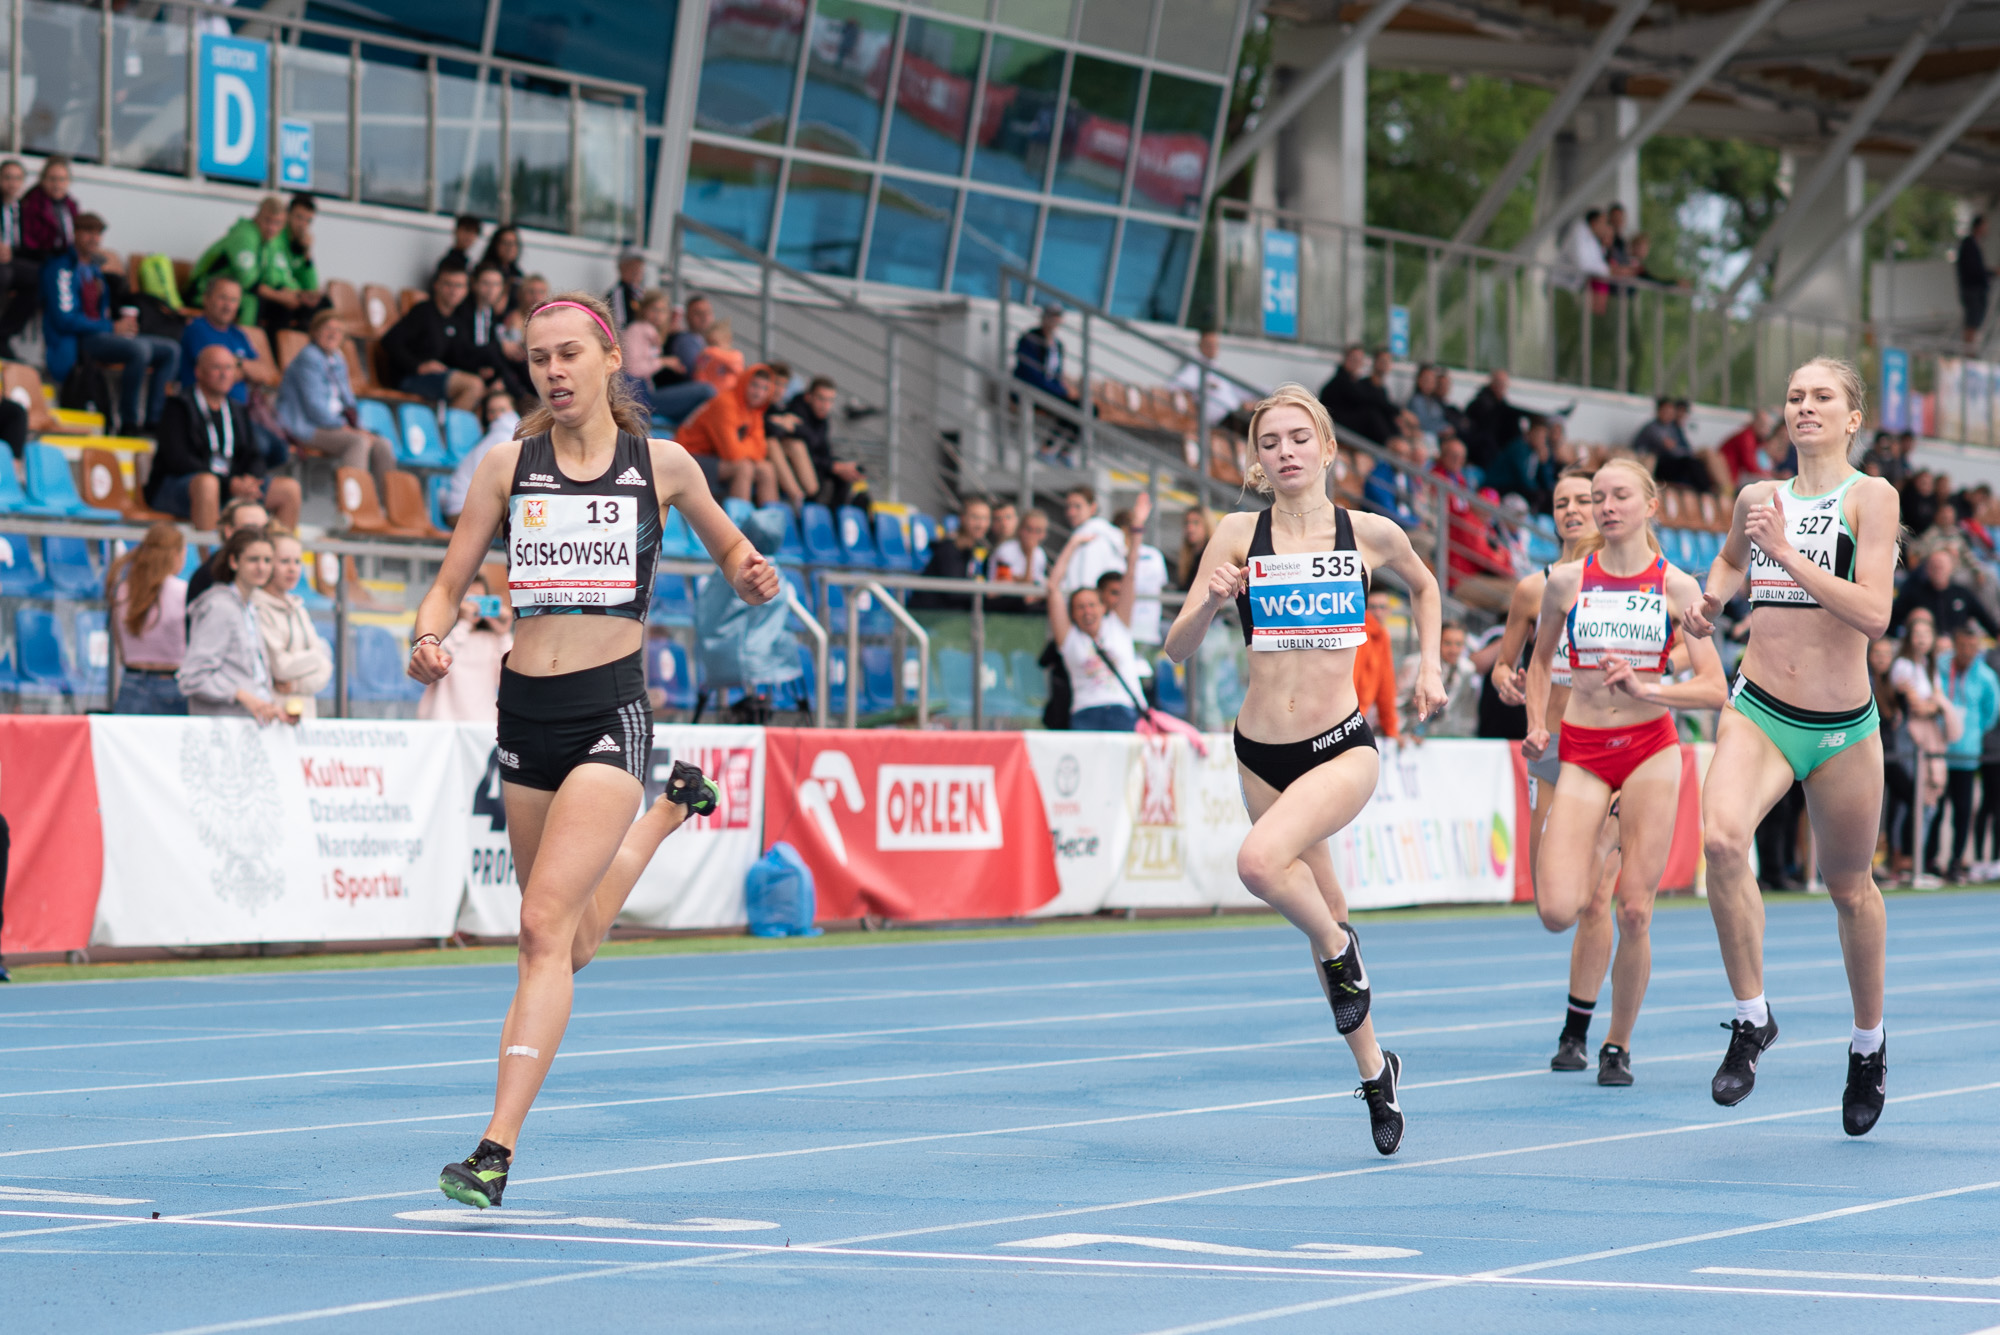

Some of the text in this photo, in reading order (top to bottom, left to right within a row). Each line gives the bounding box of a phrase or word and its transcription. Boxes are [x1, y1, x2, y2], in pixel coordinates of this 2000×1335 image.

[214, 72, 256, 166] D
[529, 473, 554, 482] SMS
[615, 478, 647, 486] adidas
[586, 501, 619, 524] 13
[1796, 515, 1833, 535] 527
[516, 538, 630, 566] ŚCISŁOWSKA
[1264, 562, 1301, 572] lubelskie
[1312, 556, 1355, 578] 535
[534, 592, 606, 603] LUBLIN 2021
[1259, 590, 1357, 617] WÓJCIK
[1626, 595, 1662, 614] 574
[1757, 590, 1809, 601] LUBLIN 2021
[1578, 621, 1662, 642] WOJTKOWIAK
[1277, 638, 1342, 648] LUBLIN 2021
[1312, 711, 1364, 752] NIKE PRO
[589, 745, 620, 755] adidas
[301, 757, 384, 796] Kultury
[309, 797, 413, 823] Dziedzictwa
[887, 780, 990, 836] ORLEN
[316, 833, 424, 864] Narodowego
[993, 1233, 1424, 1260] 2
